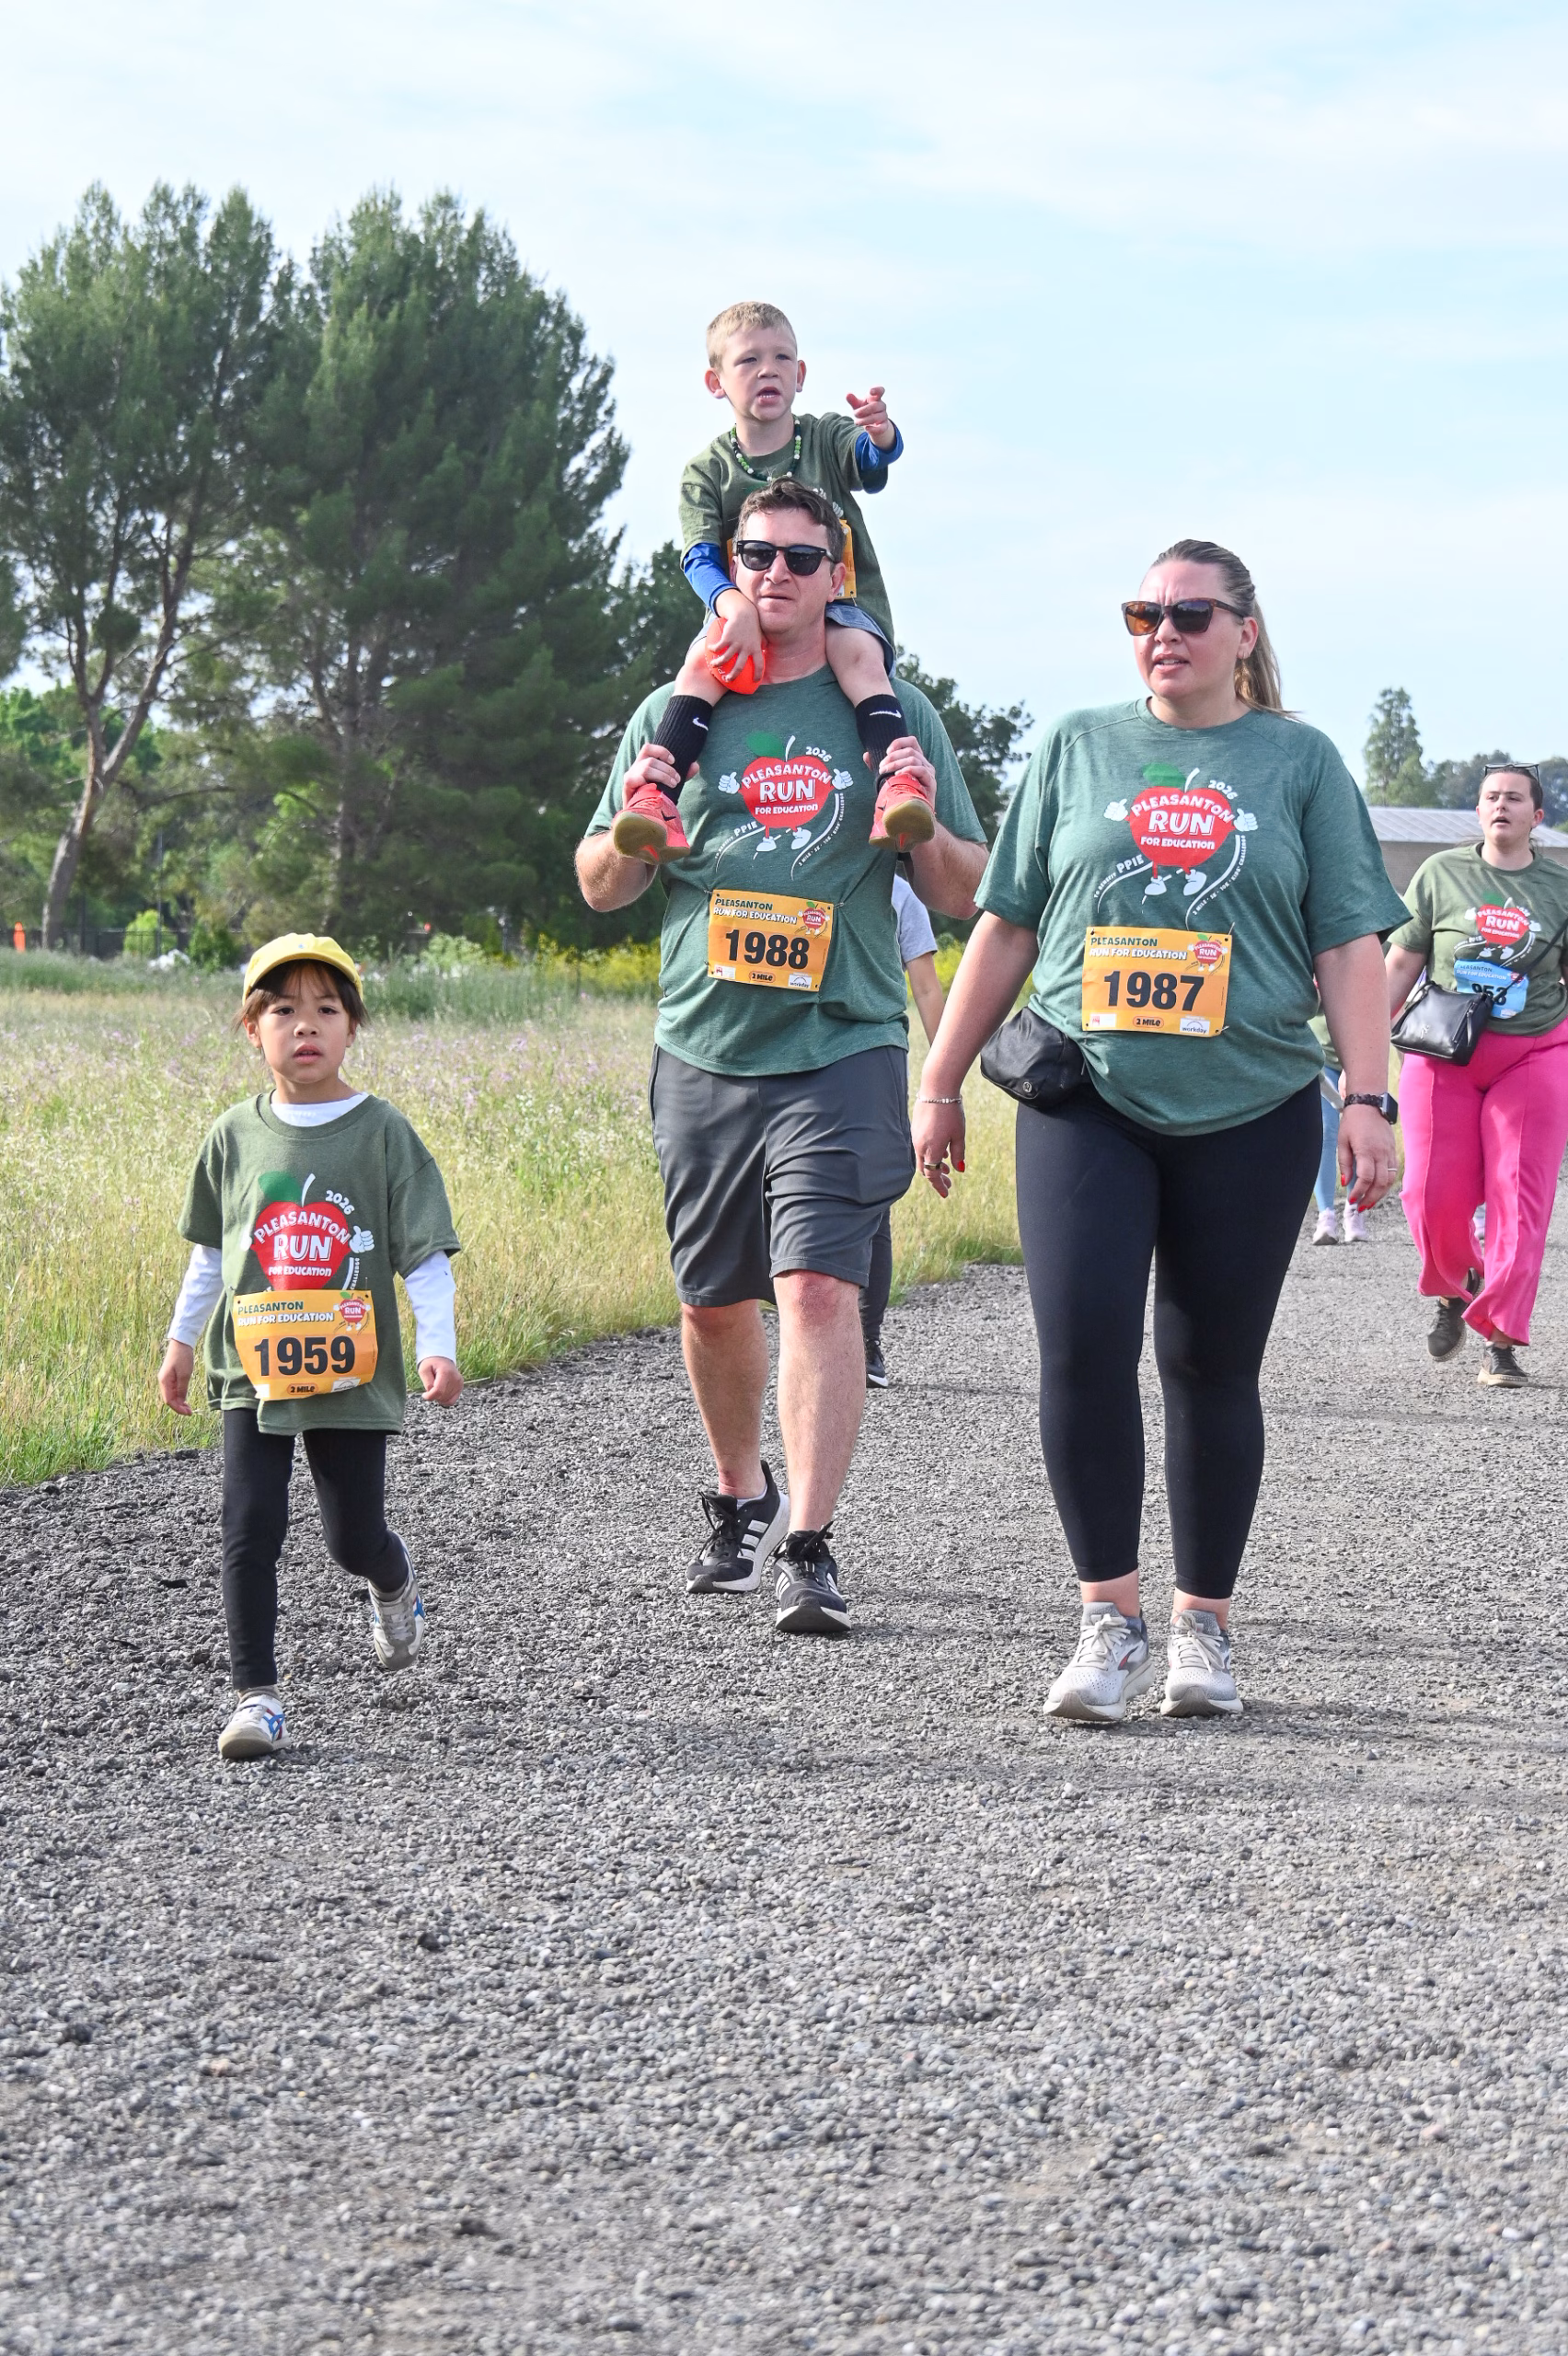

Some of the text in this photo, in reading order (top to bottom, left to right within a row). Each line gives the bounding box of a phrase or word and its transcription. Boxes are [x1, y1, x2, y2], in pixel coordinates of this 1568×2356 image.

[805, 745, 833, 763] 2026
[742, 764, 833, 789] PLEASANTON
[760, 779, 815, 803] RUN
[1208, 780, 1239, 800] 2026
[755, 803, 818, 814] FOR EDUCATION
[1131, 794, 1236, 824] PLEASANTON
[733, 821, 757, 837] PPIE
[1148, 810, 1216, 836] RUN
[1140, 837, 1216, 849] FOR EDUCATION
[1116, 854, 1144, 873] PPIE
[714, 898, 774, 911] PLEASANTON
[713, 907, 732, 916] RUN
[732, 909, 748, 919] FOR
[749, 911, 798, 925] EDUCATION
[1477, 908, 1529, 926] PLEASANTON
[1485, 916, 1520, 932] RUN
[725, 929, 810, 970] 1988
[1090, 937, 1158, 947] PLEASANTON
[1090, 947, 1110, 957] RUN
[1111, 948, 1130, 958] FOR
[1132, 949, 1188, 961] EDUCATION
[1199, 948, 1216, 956] RUN
[1478, 971, 1507, 980] EDUCATION
[1104, 970, 1205, 1011] 1987
[1182, 1026, 1207, 1034] workday
[325, 1190, 355, 1215] 2026
[254, 1211, 352, 1244] PLEASANTON
[273, 1233, 333, 1261] RUN
[268, 1266, 332, 1277] FOR EDUCATION
[237, 1300, 304, 1315] PLEASANTON
[344, 1307, 362, 1315] RUN
[236, 1315, 257, 1326] RUN
[257, 1313, 277, 1324] FOR
[277, 1312, 335, 1323] EDUCATION
[254, 1335, 355, 1377] 1959
